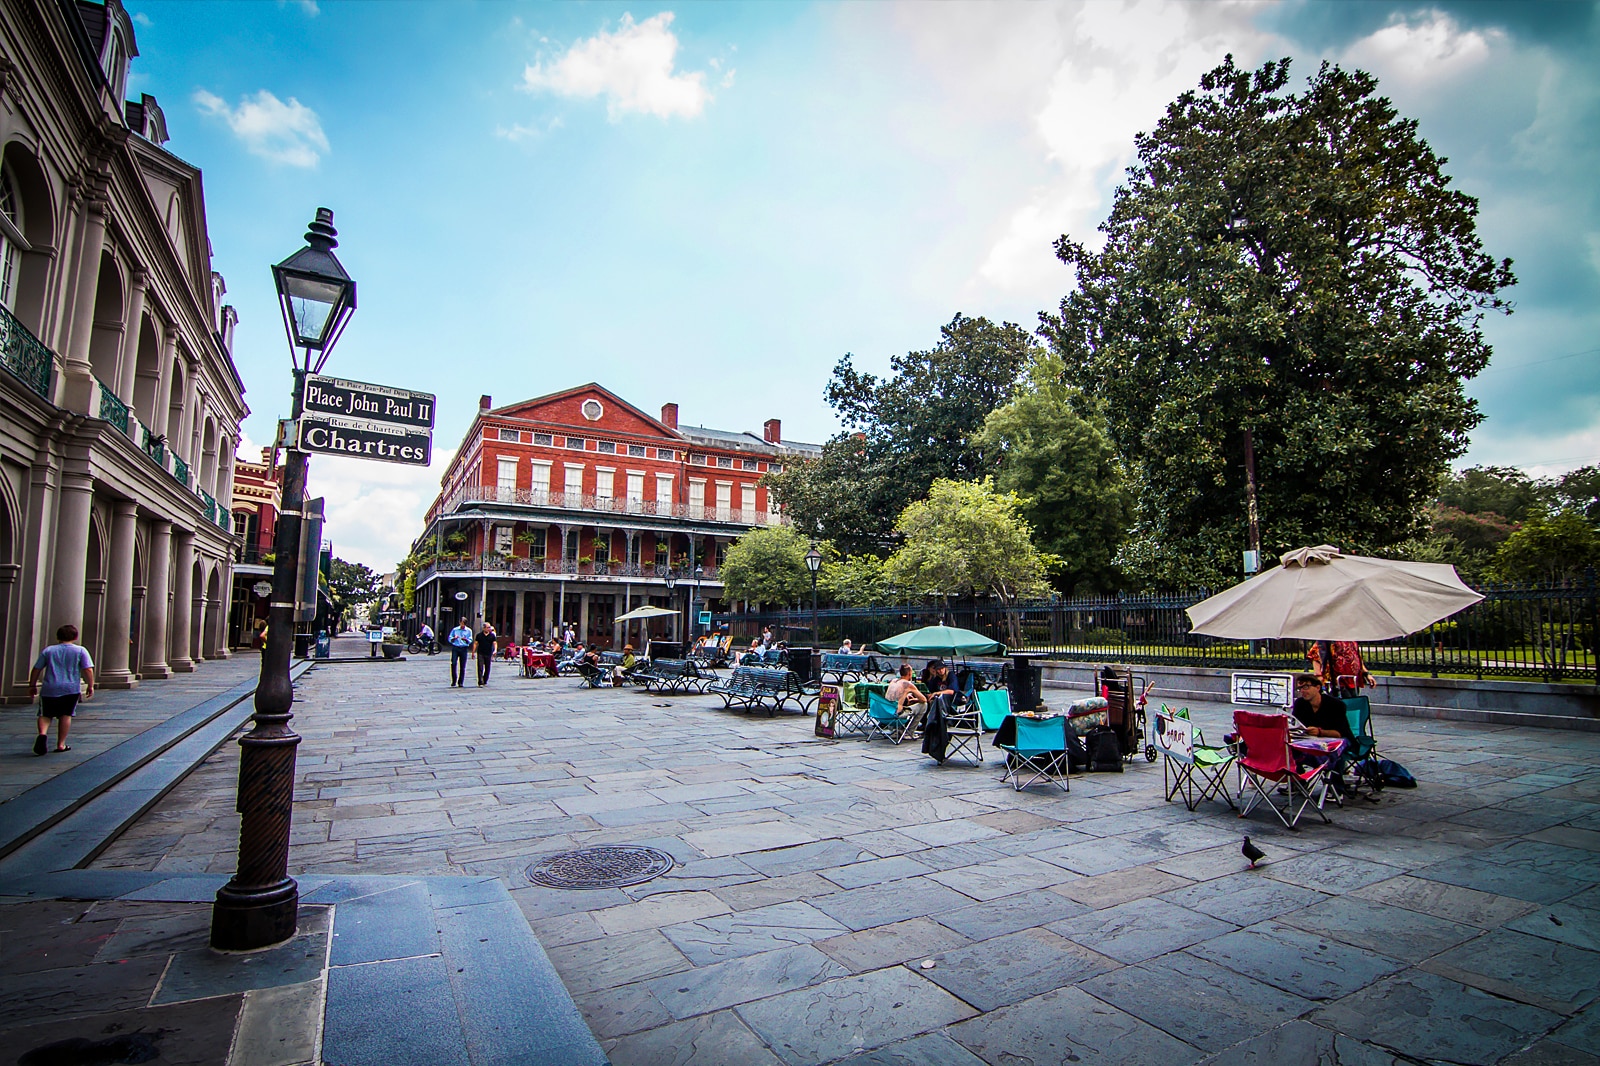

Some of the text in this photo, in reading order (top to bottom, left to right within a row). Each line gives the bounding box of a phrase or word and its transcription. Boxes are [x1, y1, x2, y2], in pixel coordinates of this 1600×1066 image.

[347, 381, 361, 389] Place
[363, 384, 392, 394] Jean-Paul
[393, 389, 409, 397] Deux
[307, 386, 430, 421] Place John Paul II
[331, 418, 404, 435] Rue de Chartres
[306, 428, 424, 459] Chartres
